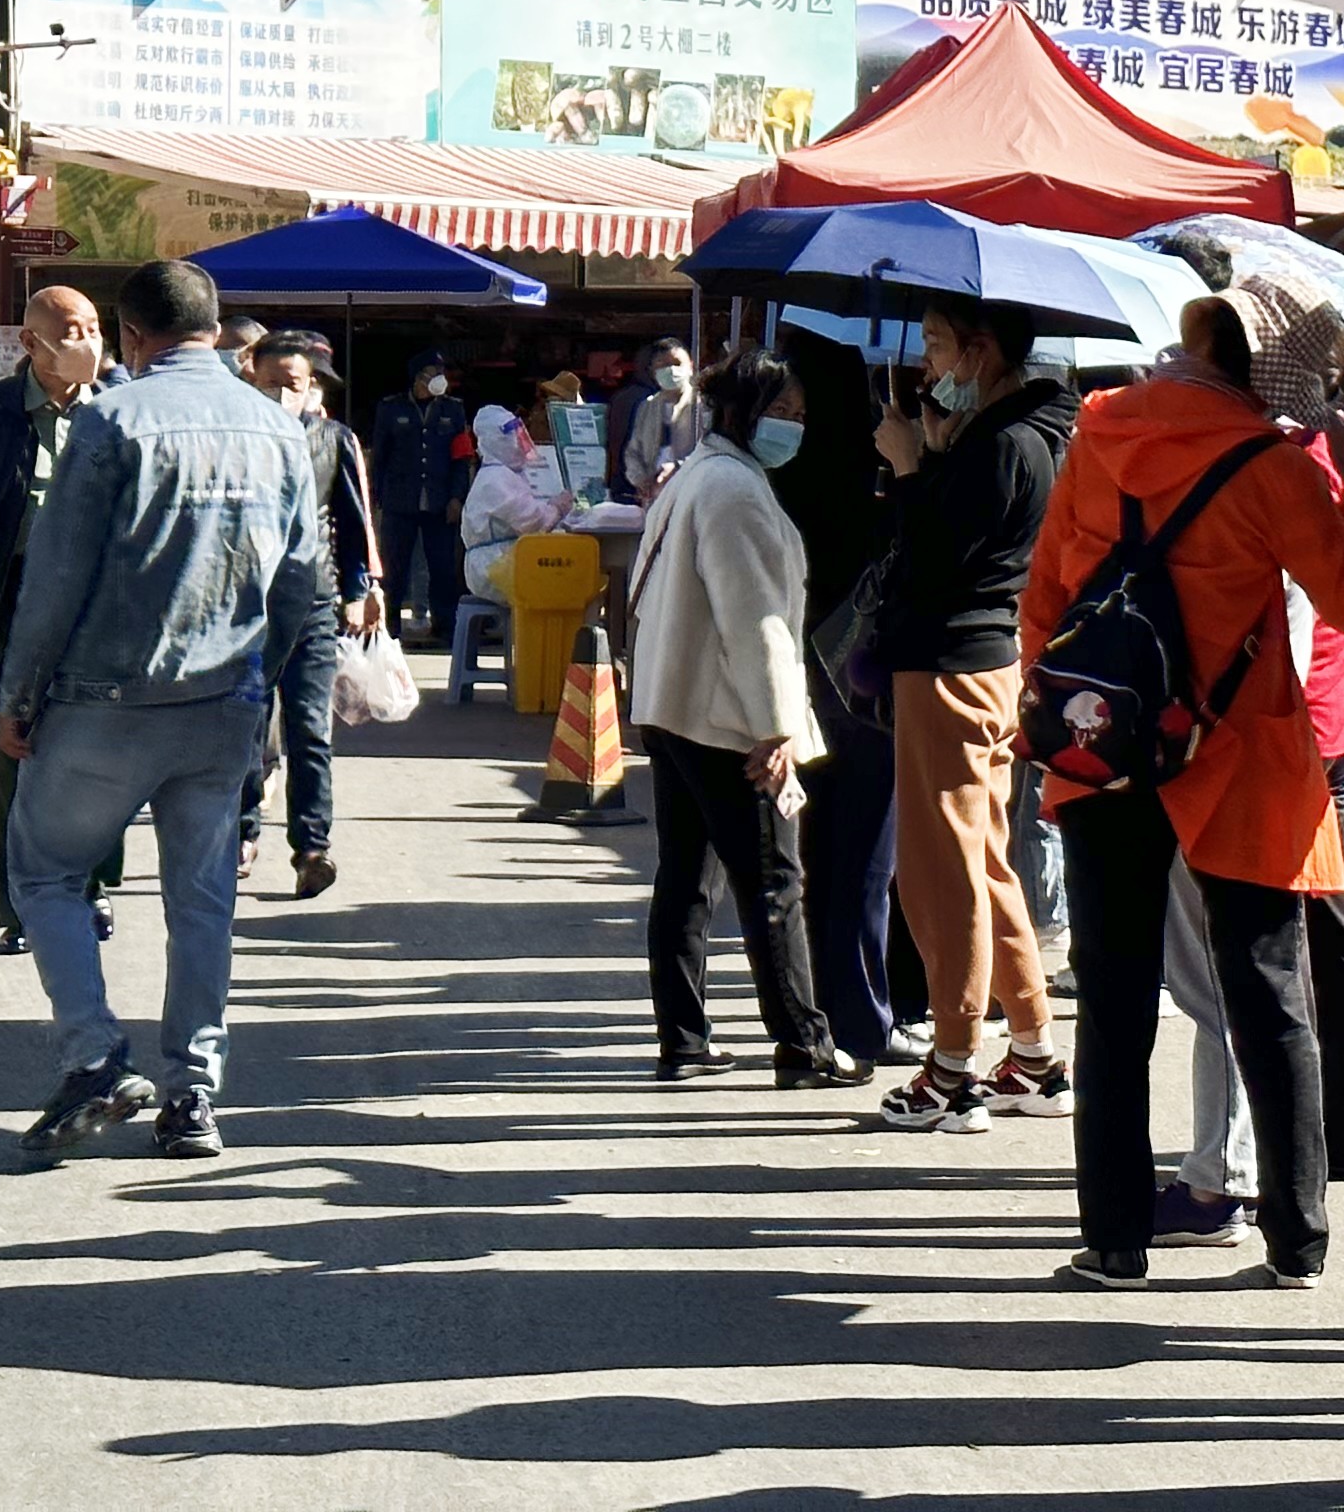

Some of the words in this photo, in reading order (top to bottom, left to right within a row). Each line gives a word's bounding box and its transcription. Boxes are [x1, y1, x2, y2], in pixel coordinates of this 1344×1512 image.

[240, 22, 295, 42] 保证质量
[575, 19, 733, 57] 请到2号大棚二楼
[239, 50, 296, 70] 保障供给
[1058, 45, 1145, 88] 春城
[1158, 53, 1295, 98] 宜居春城
[239, 79, 296, 99] 服从大局
[238, 108, 296, 128] 产销对接
